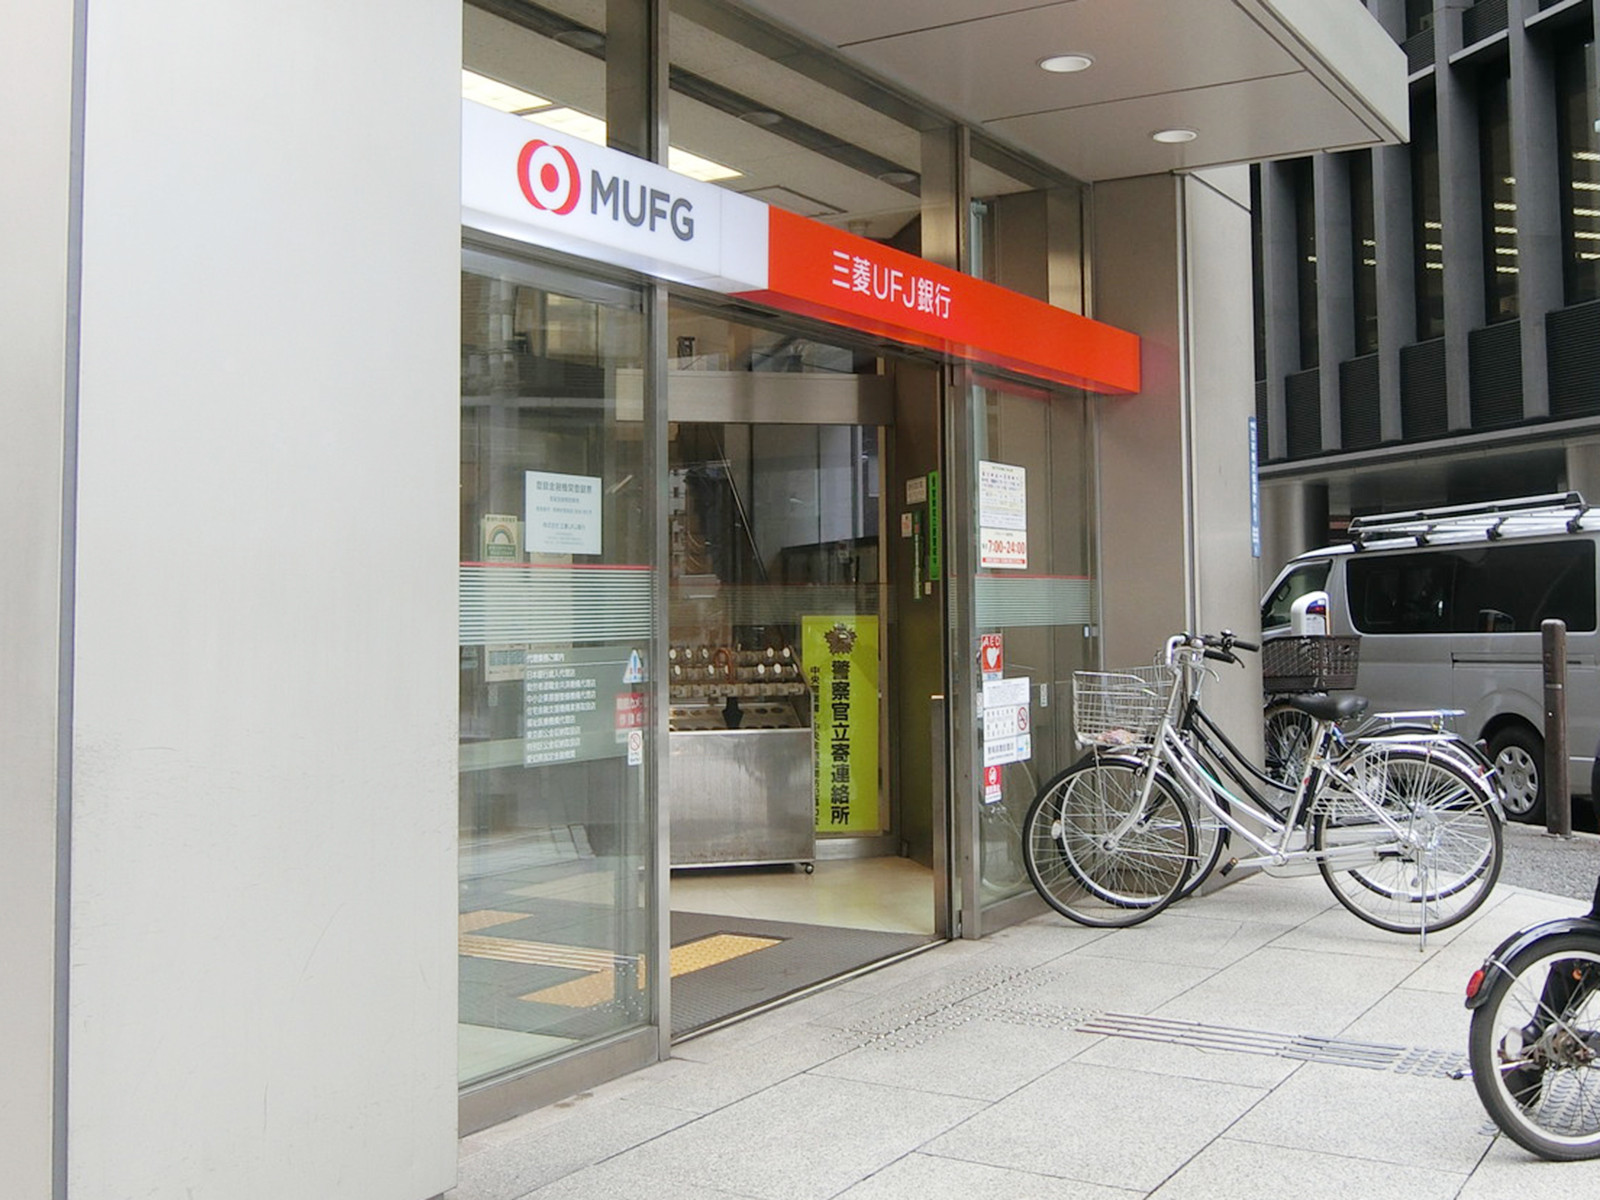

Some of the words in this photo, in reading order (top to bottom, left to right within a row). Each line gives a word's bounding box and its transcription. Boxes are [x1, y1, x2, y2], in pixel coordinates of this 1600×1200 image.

[590, 169, 694, 241] MUFG
[832, 250, 951, 319] 三菱UFJ銀行
[983, 637, 1001, 648] AED
[831, 660, 850, 825] 警察官立寄連絡所
